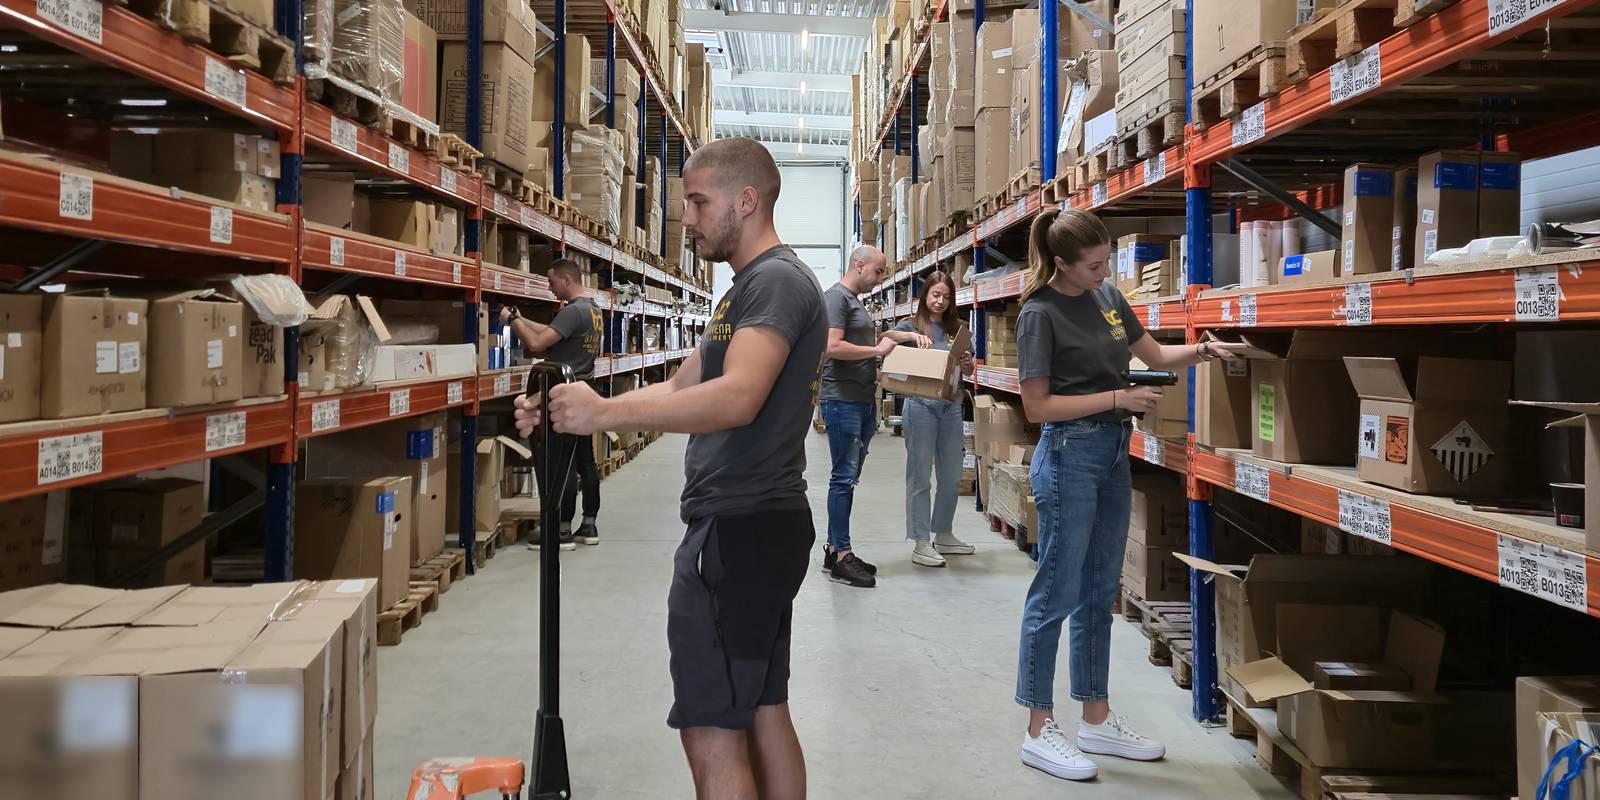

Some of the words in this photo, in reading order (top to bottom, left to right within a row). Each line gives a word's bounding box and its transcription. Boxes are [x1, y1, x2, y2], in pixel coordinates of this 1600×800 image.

[1490, 10, 1510, 30] D013
[1355, 76, 1368, 91] E014
[61, 199, 77, 212] C014
[1347, 309, 1360, 320] C014
[1516, 300, 1538, 315] C013
[249, 325, 274, 347] Lead
[256, 344, 276, 364] Pak
[40, 467, 57, 480] A014
[72, 460, 89, 473] B014
[1364, 521, 1378, 535] B014
[1500, 567, 1521, 585] A013
[1541, 577, 1564, 597] B013
